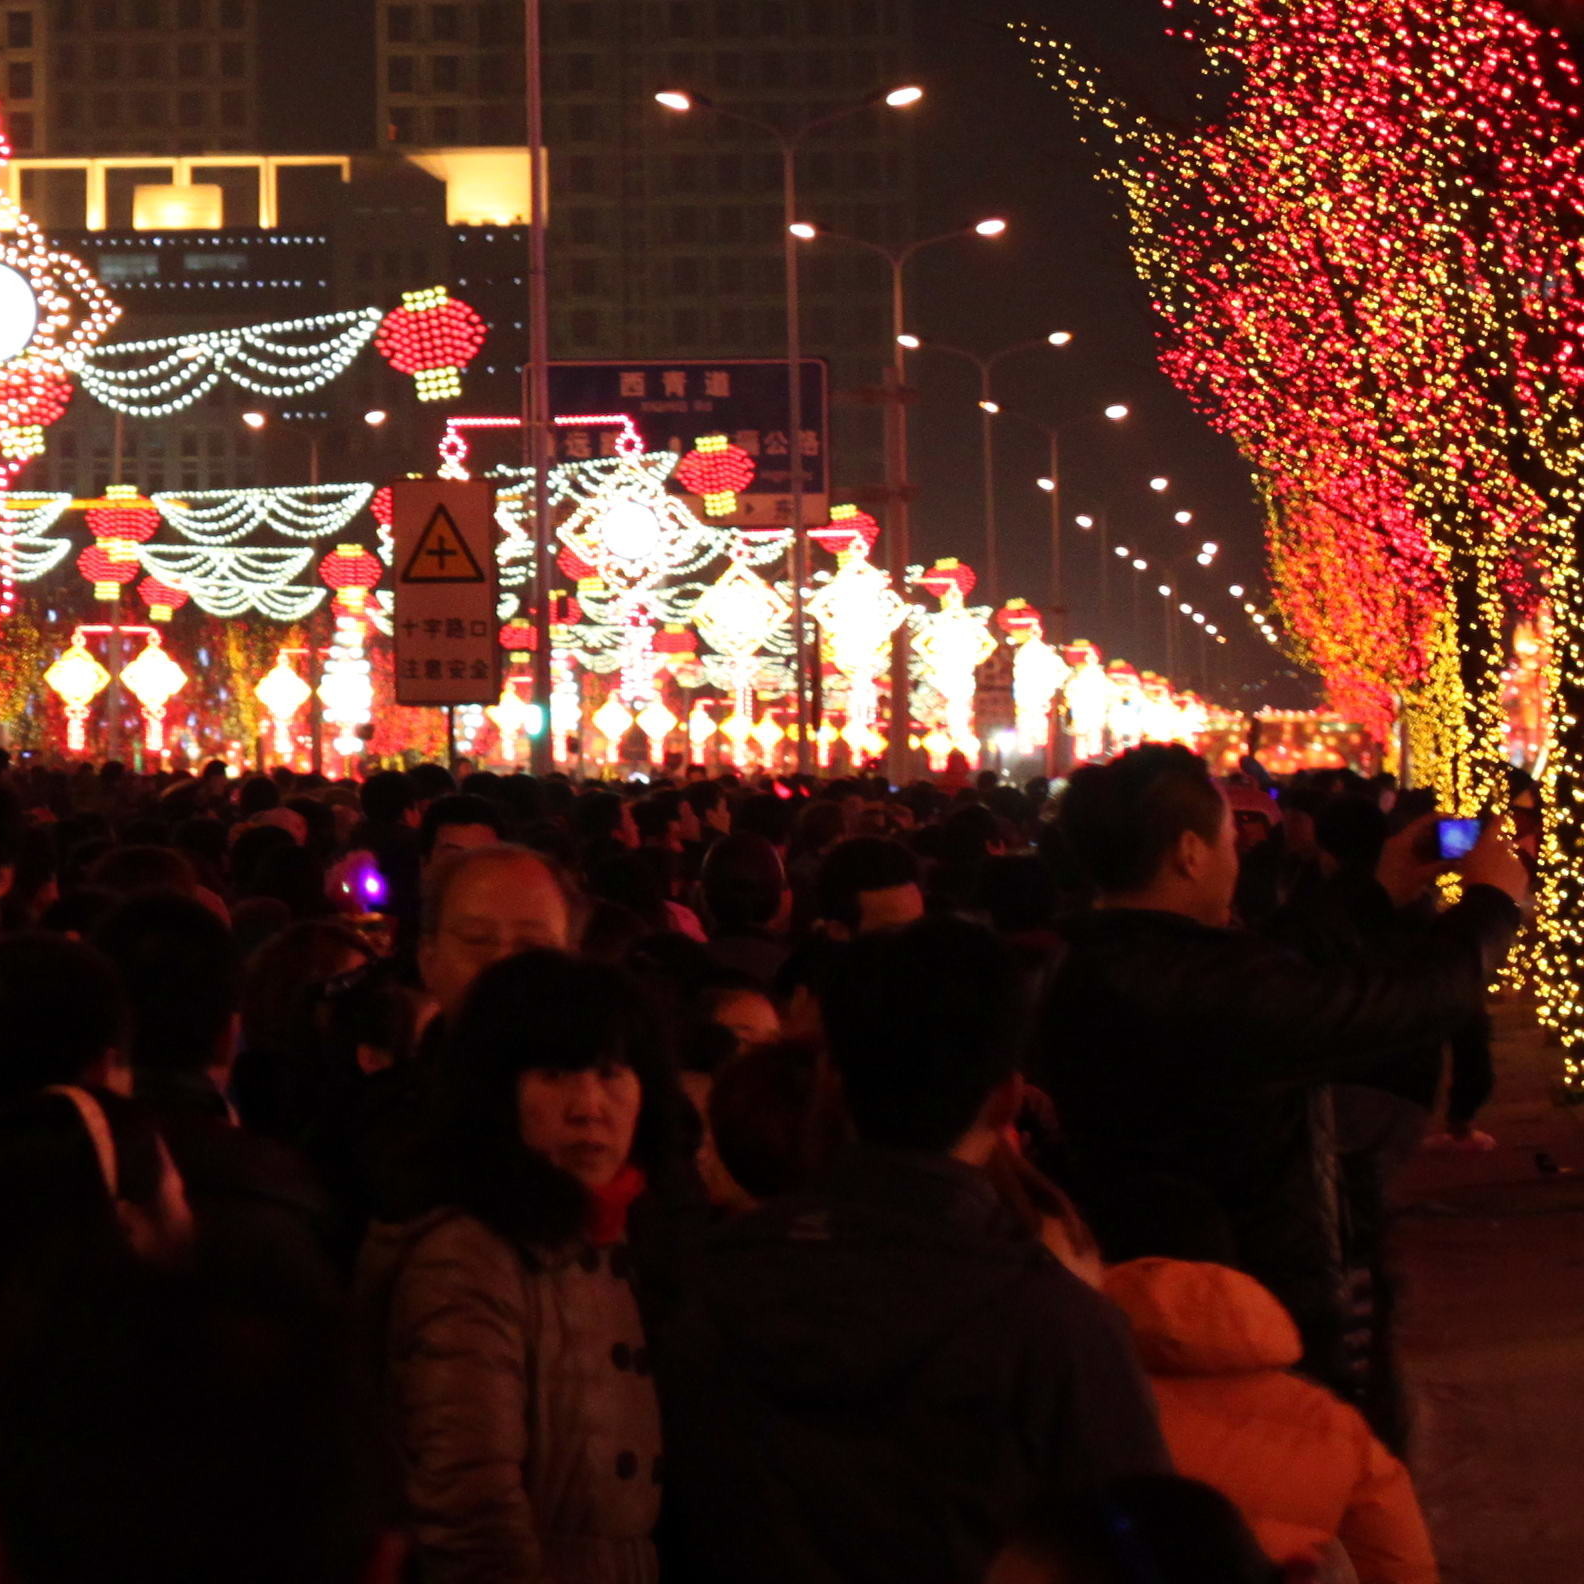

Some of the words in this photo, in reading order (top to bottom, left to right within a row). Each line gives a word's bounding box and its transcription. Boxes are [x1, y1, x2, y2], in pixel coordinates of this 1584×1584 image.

[619, 371, 731, 398] 西青道
[401, 618, 487, 640] 十字路口
[399, 658, 489, 681] 注意安全
